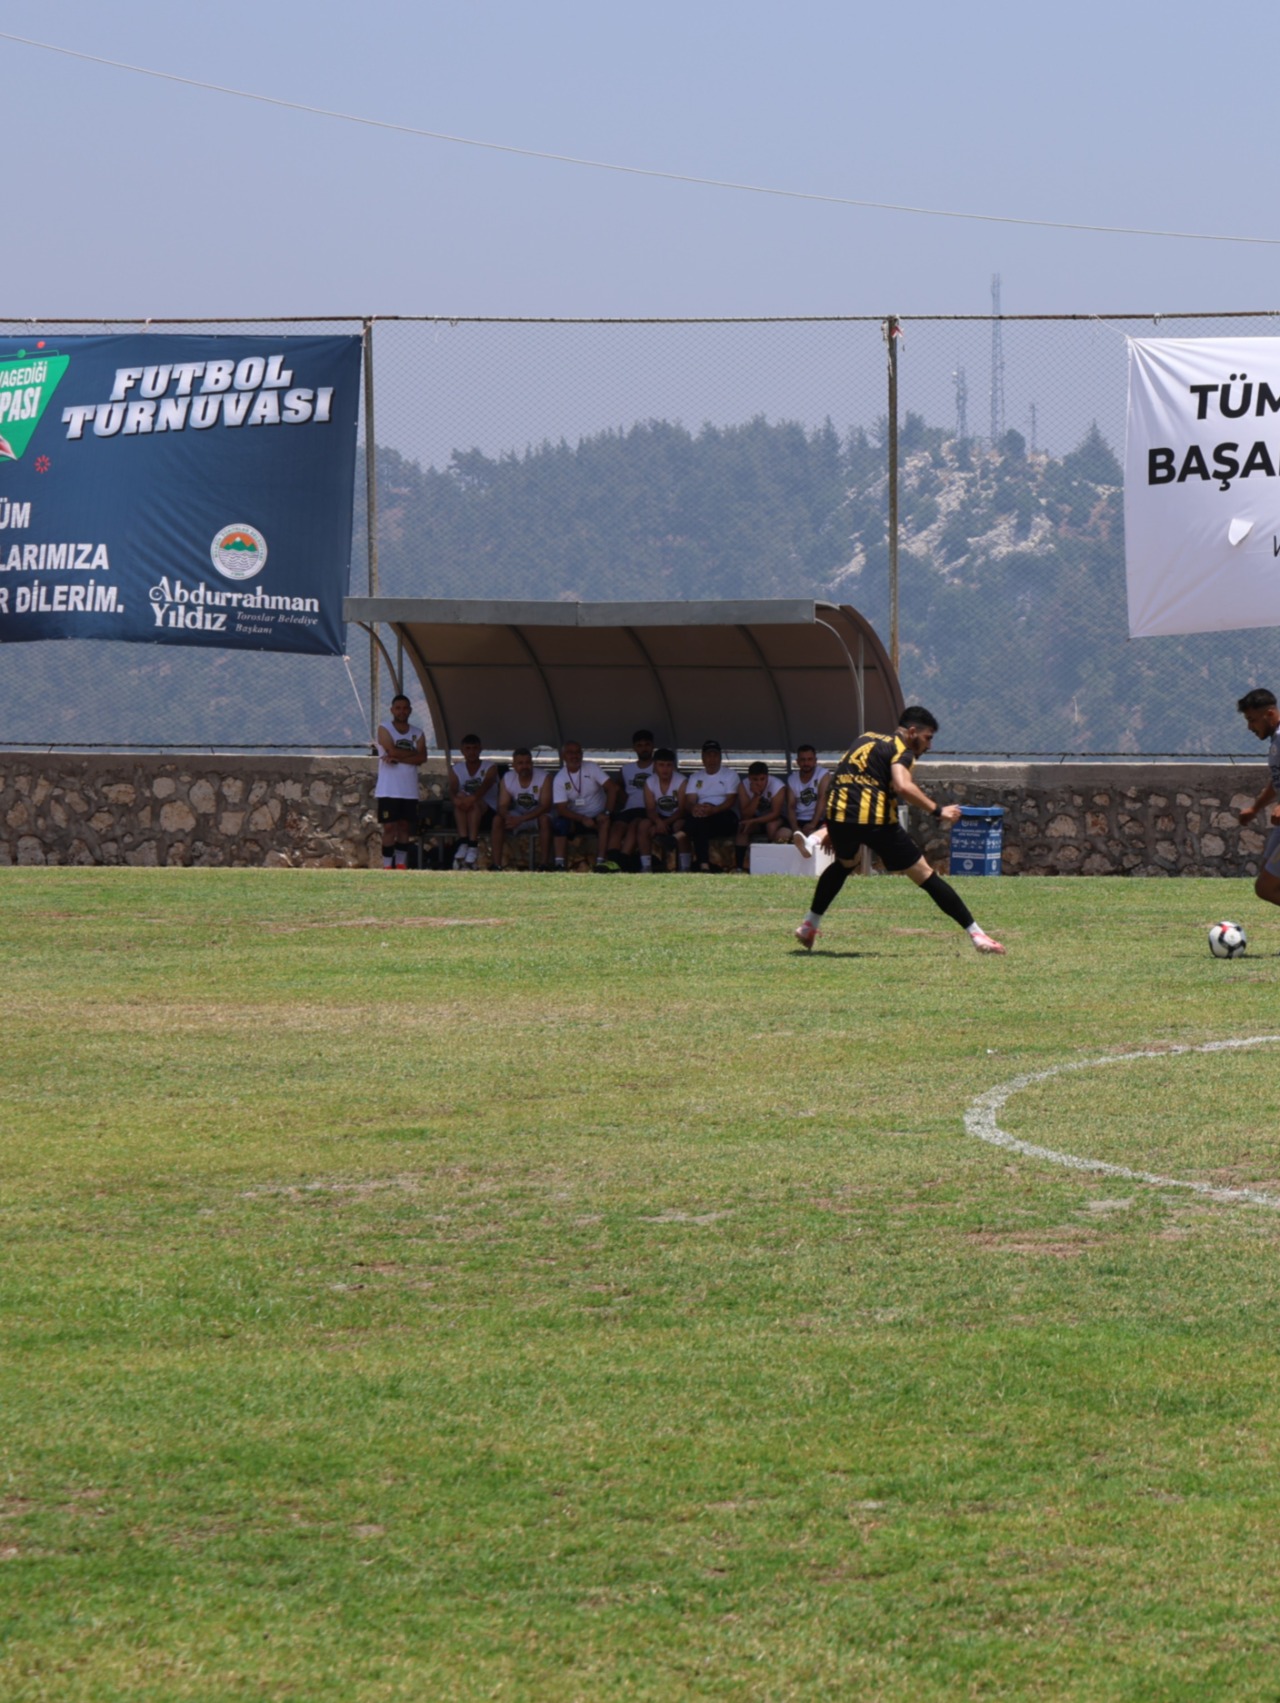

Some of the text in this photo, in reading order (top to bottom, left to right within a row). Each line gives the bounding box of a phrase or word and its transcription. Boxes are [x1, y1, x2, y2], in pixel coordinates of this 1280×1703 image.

[109, 354, 294, 402] FUTBOL
[60, 386, 335, 440] TURNUVASI
[15, 578, 125, 614] DİLERİM.
[148, 575, 320, 613] Abdurrahman
[149, 602, 228, 632] Yıldız
[234, 622, 273, 634] Başkanı
[236, 610, 319, 626] Toroslar Belediye
